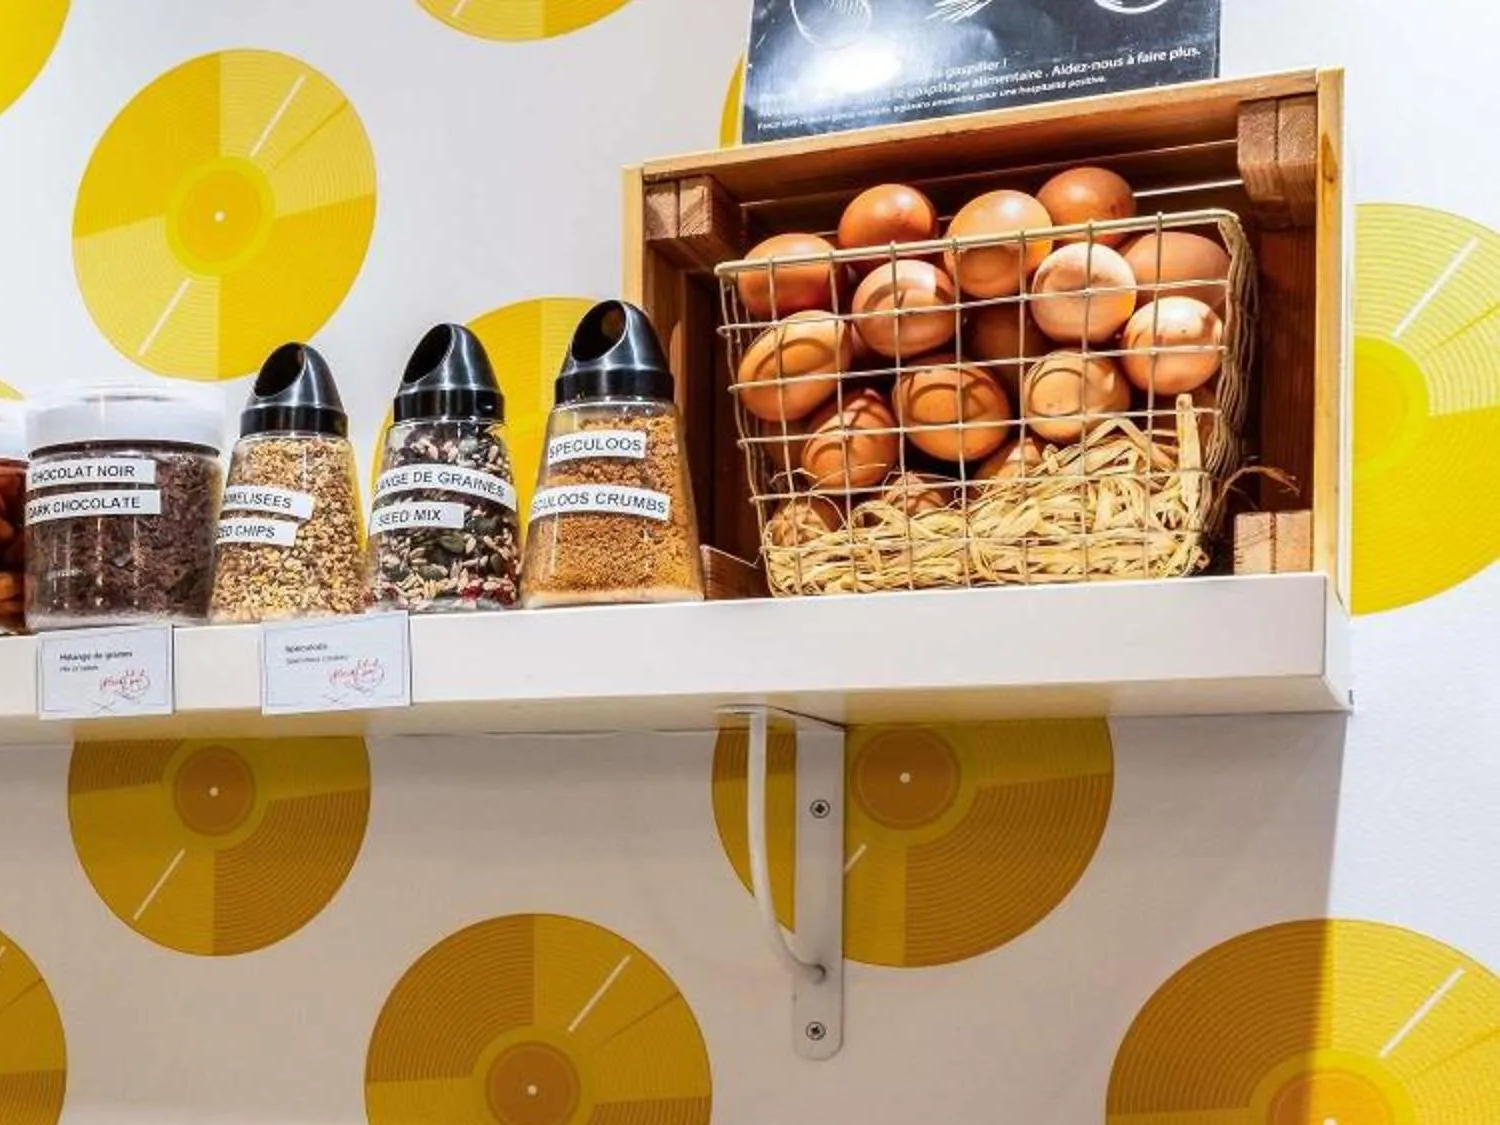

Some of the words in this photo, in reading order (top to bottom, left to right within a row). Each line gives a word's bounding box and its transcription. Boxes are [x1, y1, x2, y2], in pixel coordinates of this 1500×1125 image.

[1137, 51, 1166, 64] faire
[1168, 46, 1201, 61] plus.
[31, 465, 93, 484] CHOCOLAT
[97, 465, 136, 478] NOIR
[413, 471, 433, 483] DE
[437, 471, 506, 497] GRAINES
[52, 495, 141, 514] CHOCOLATE
[595, 492, 666, 514] CRUMBS
[378, 510, 410, 526] SEED
[413, 509, 442, 522] MIX
[234, 525, 276, 539] CHIPS
